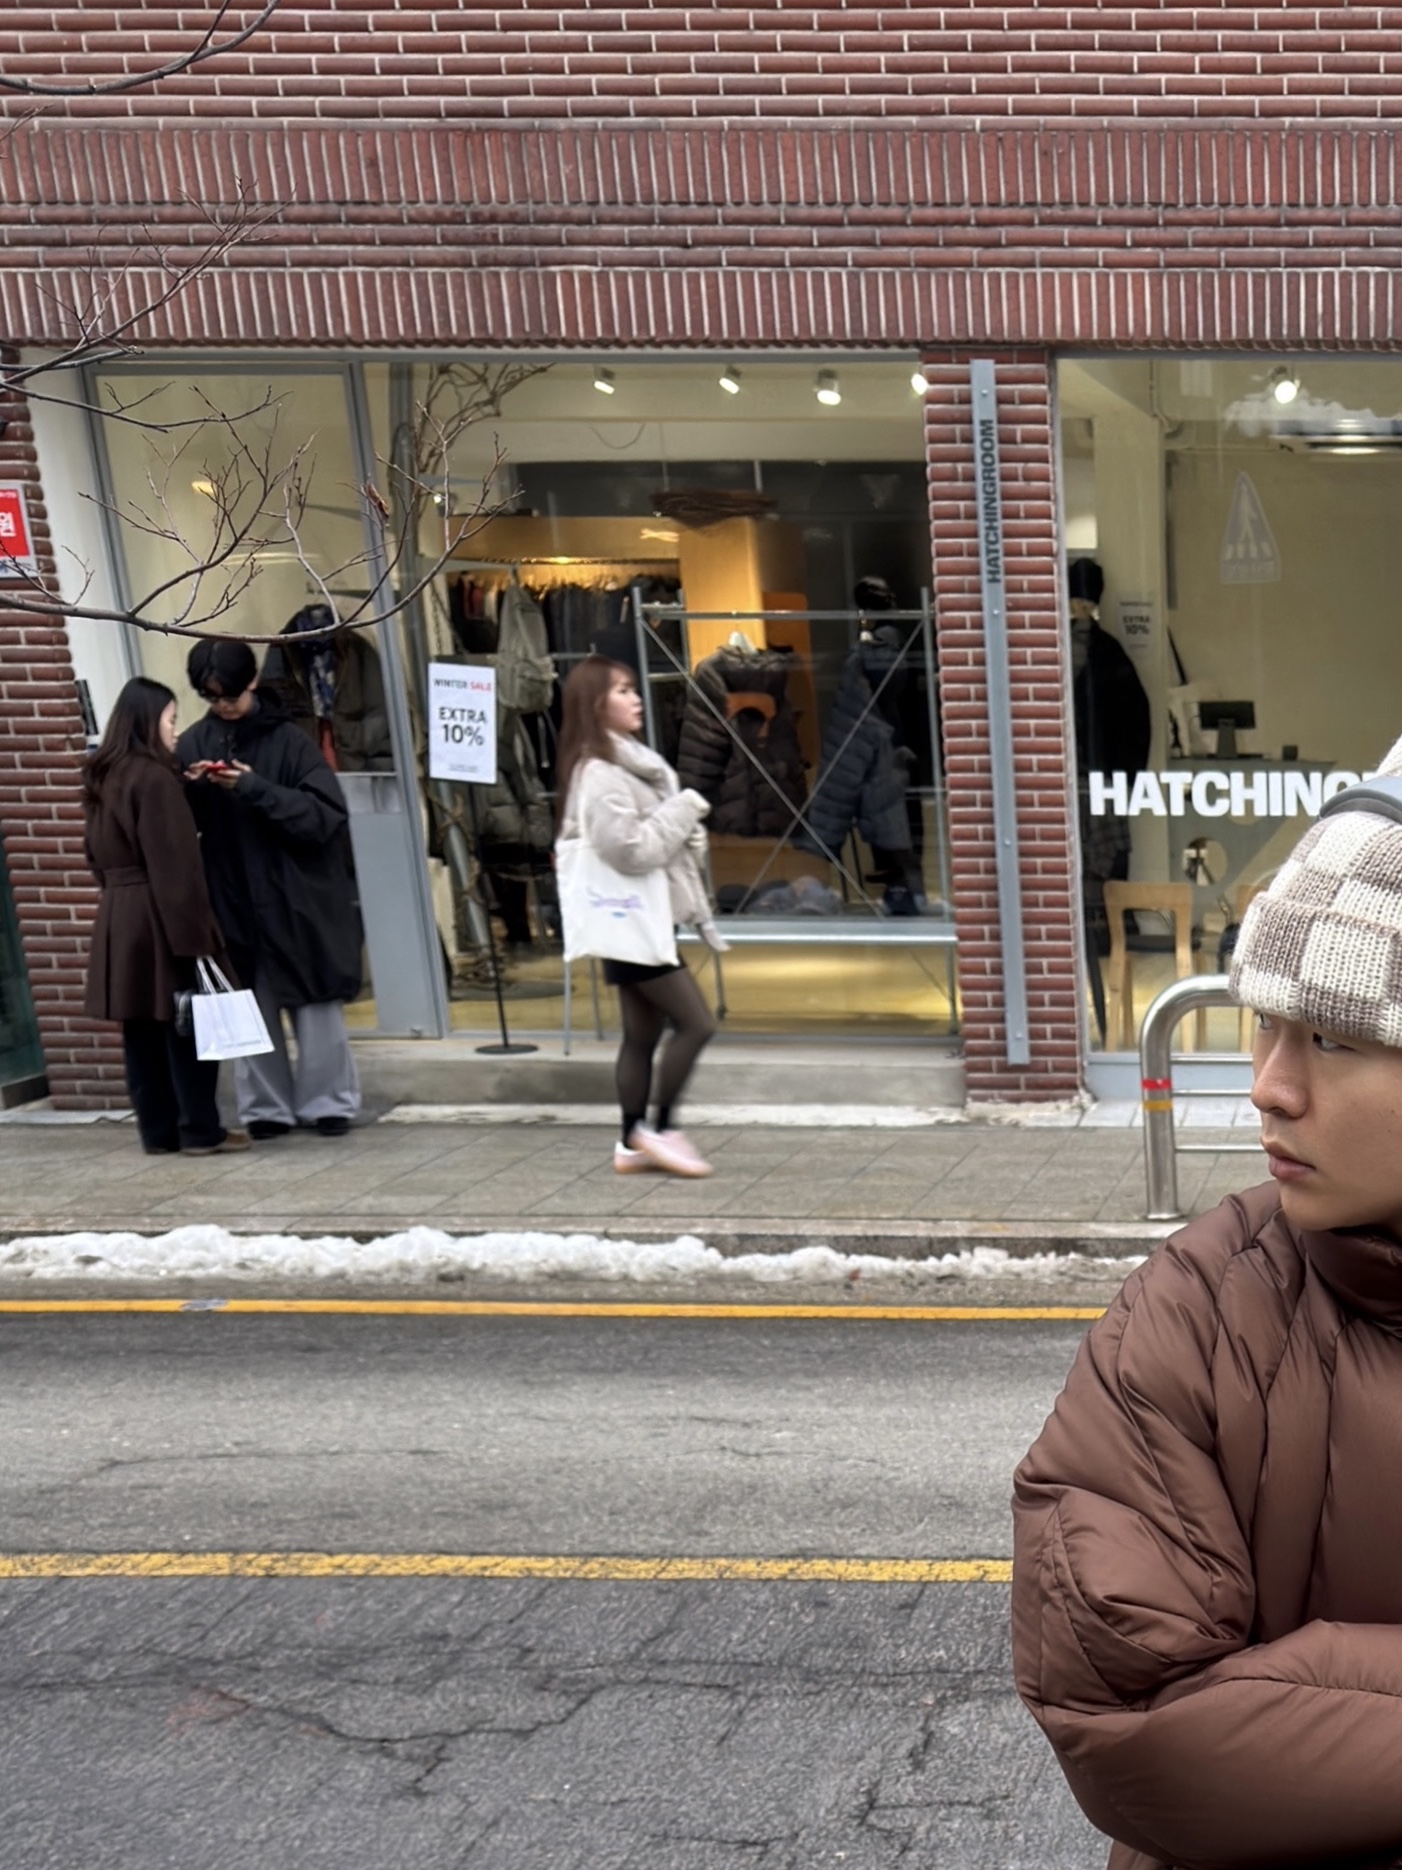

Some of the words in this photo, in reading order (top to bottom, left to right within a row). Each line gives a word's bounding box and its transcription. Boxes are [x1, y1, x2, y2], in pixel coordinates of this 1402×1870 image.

[979, 419, 1002, 583] HATCHINGROOM
[439, 706, 487, 724] EXTRA
[442, 723, 485, 746] 10%
